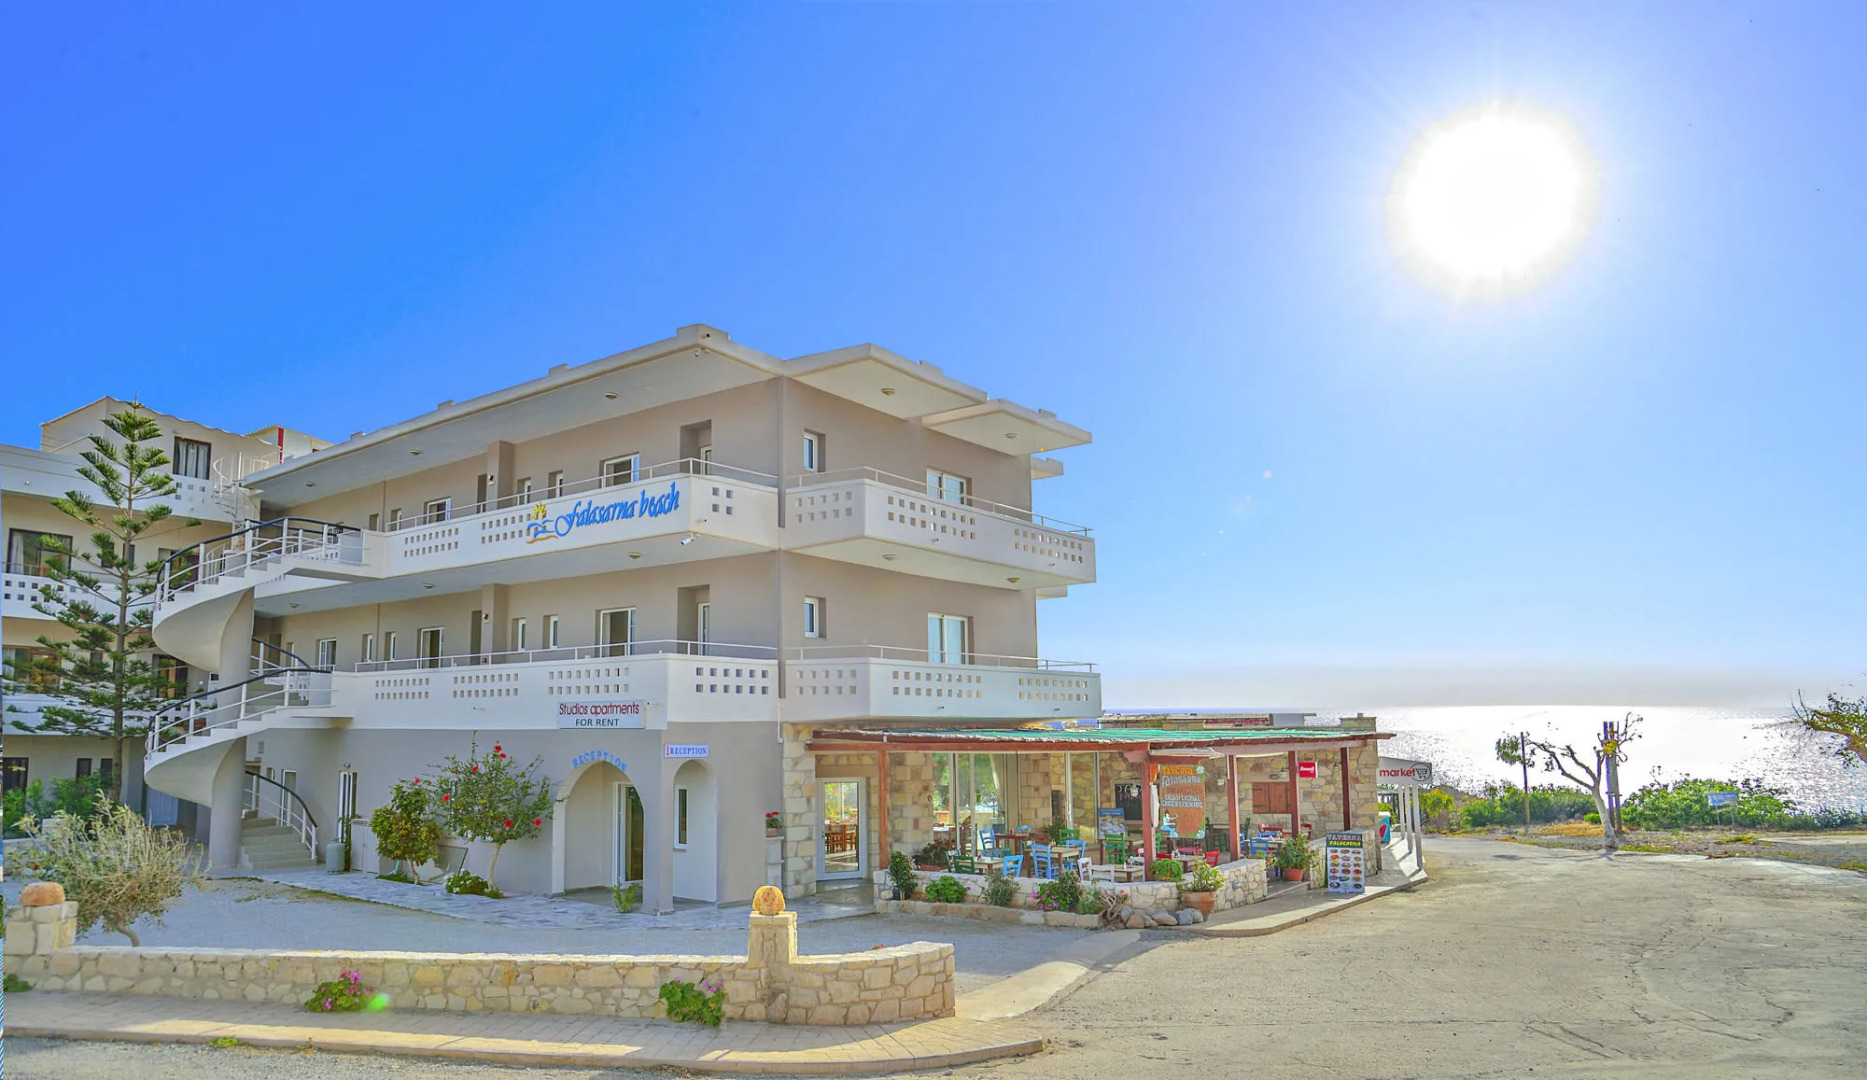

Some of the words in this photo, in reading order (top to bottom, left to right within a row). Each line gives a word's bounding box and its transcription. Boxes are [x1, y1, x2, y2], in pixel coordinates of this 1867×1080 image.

[638, 481, 680, 518] beach
[559, 702, 588, 715] Studios
[590, 701, 640, 717] apartments
[575, 718, 593, 727] FOR
[595, 718, 619, 727] RENT
[670, 747, 707, 755] RECEPTION
[572, 750, 627, 772] RECEPTION
[1379, 768, 1416, 777] market
